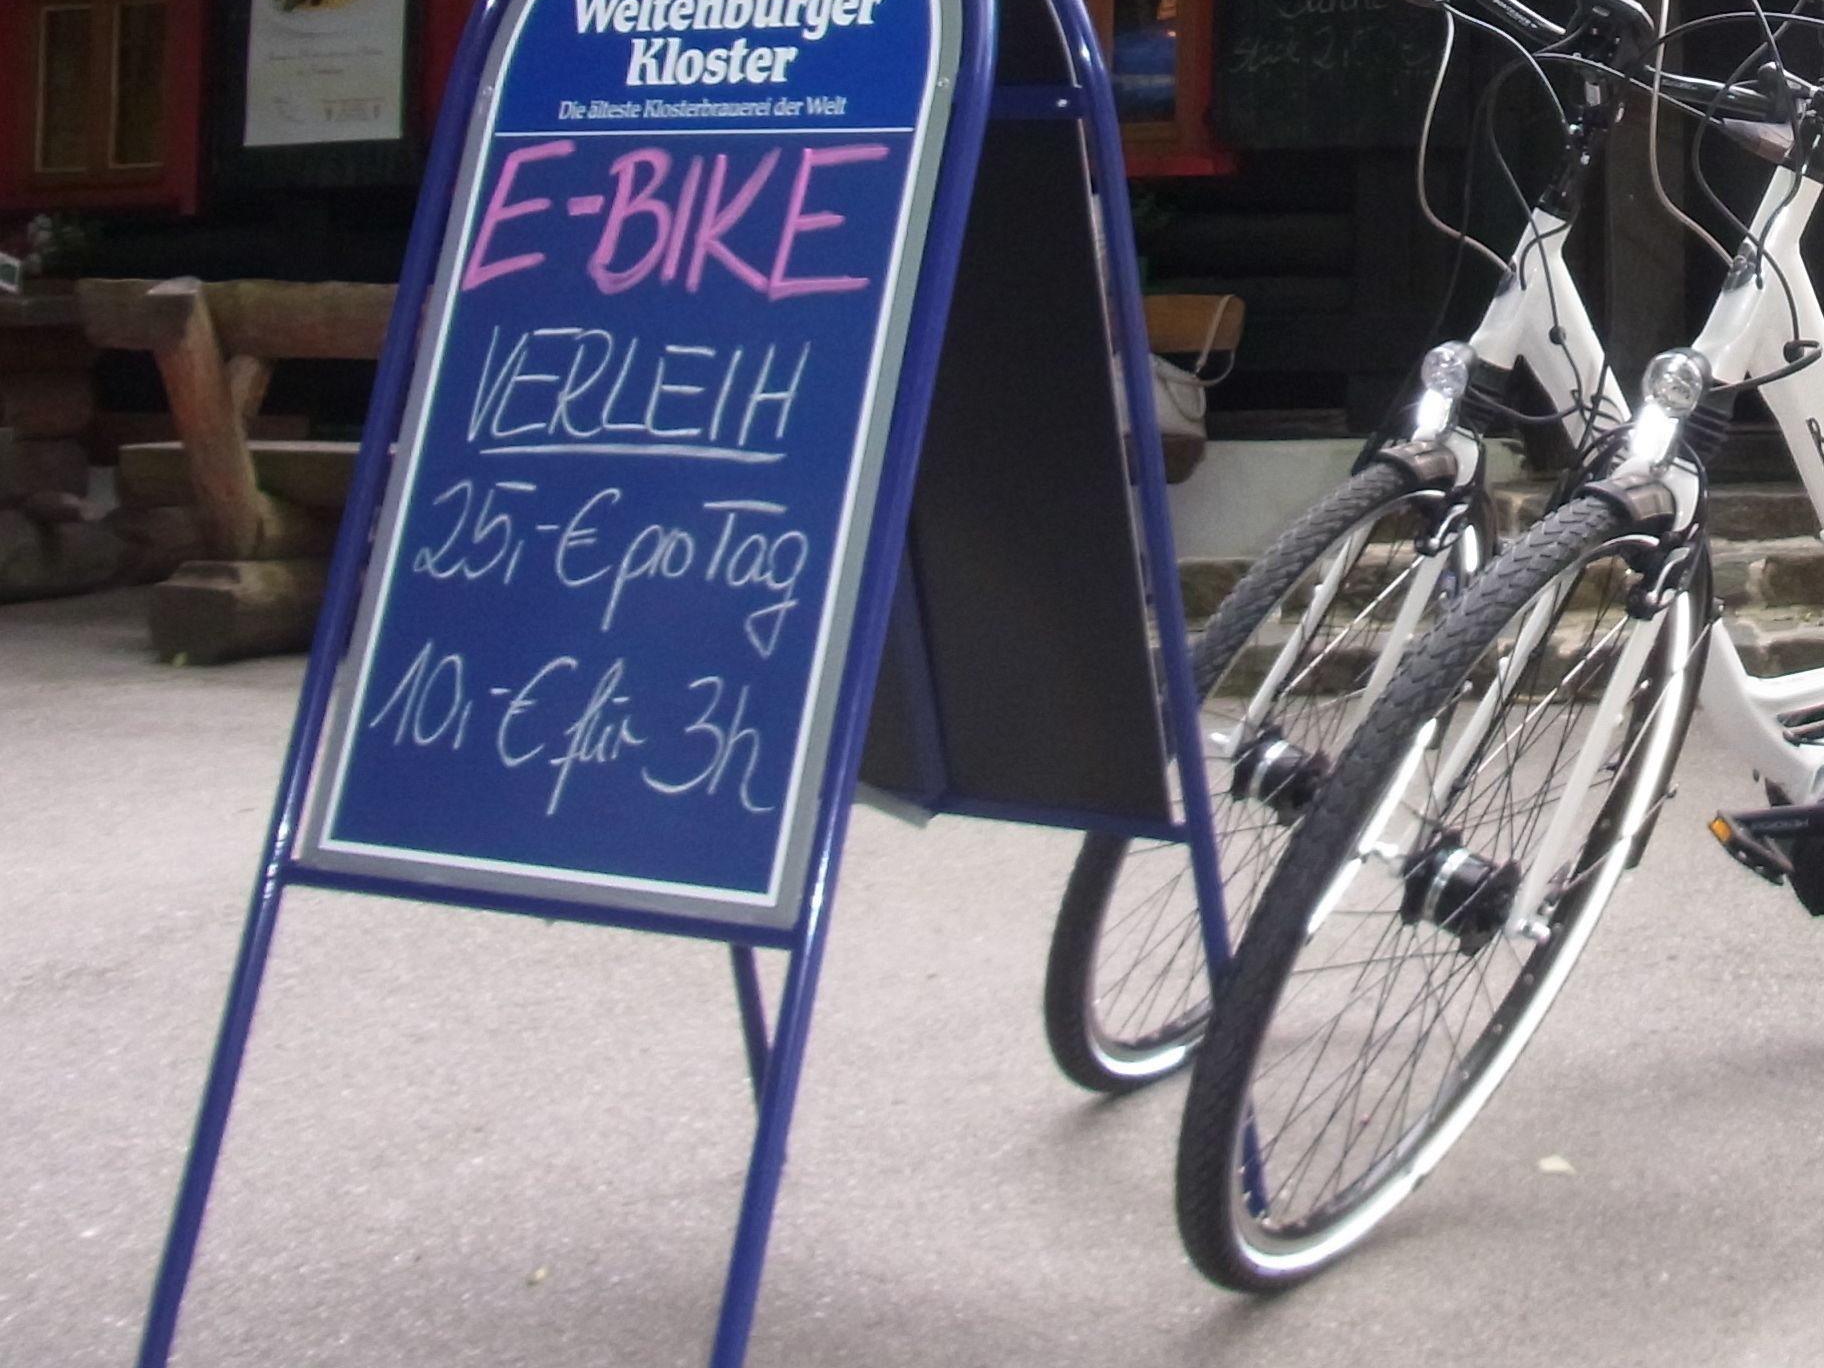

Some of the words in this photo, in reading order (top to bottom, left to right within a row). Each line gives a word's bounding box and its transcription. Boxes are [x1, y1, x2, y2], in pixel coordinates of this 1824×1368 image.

[559, 101, 586, 120] Die
[587, 100, 641, 119] älteste
[643, 98, 771, 118] Klosterbrauerei
[773, 97, 803, 116] der
[805, 95, 847, 115] Welt
[626, 39, 798, 86] Kloster
[460, 139, 891, 302] E-BIKE
[467, 326, 810, 446] VERLEIH
[704, 499, 809, 660] Tag
